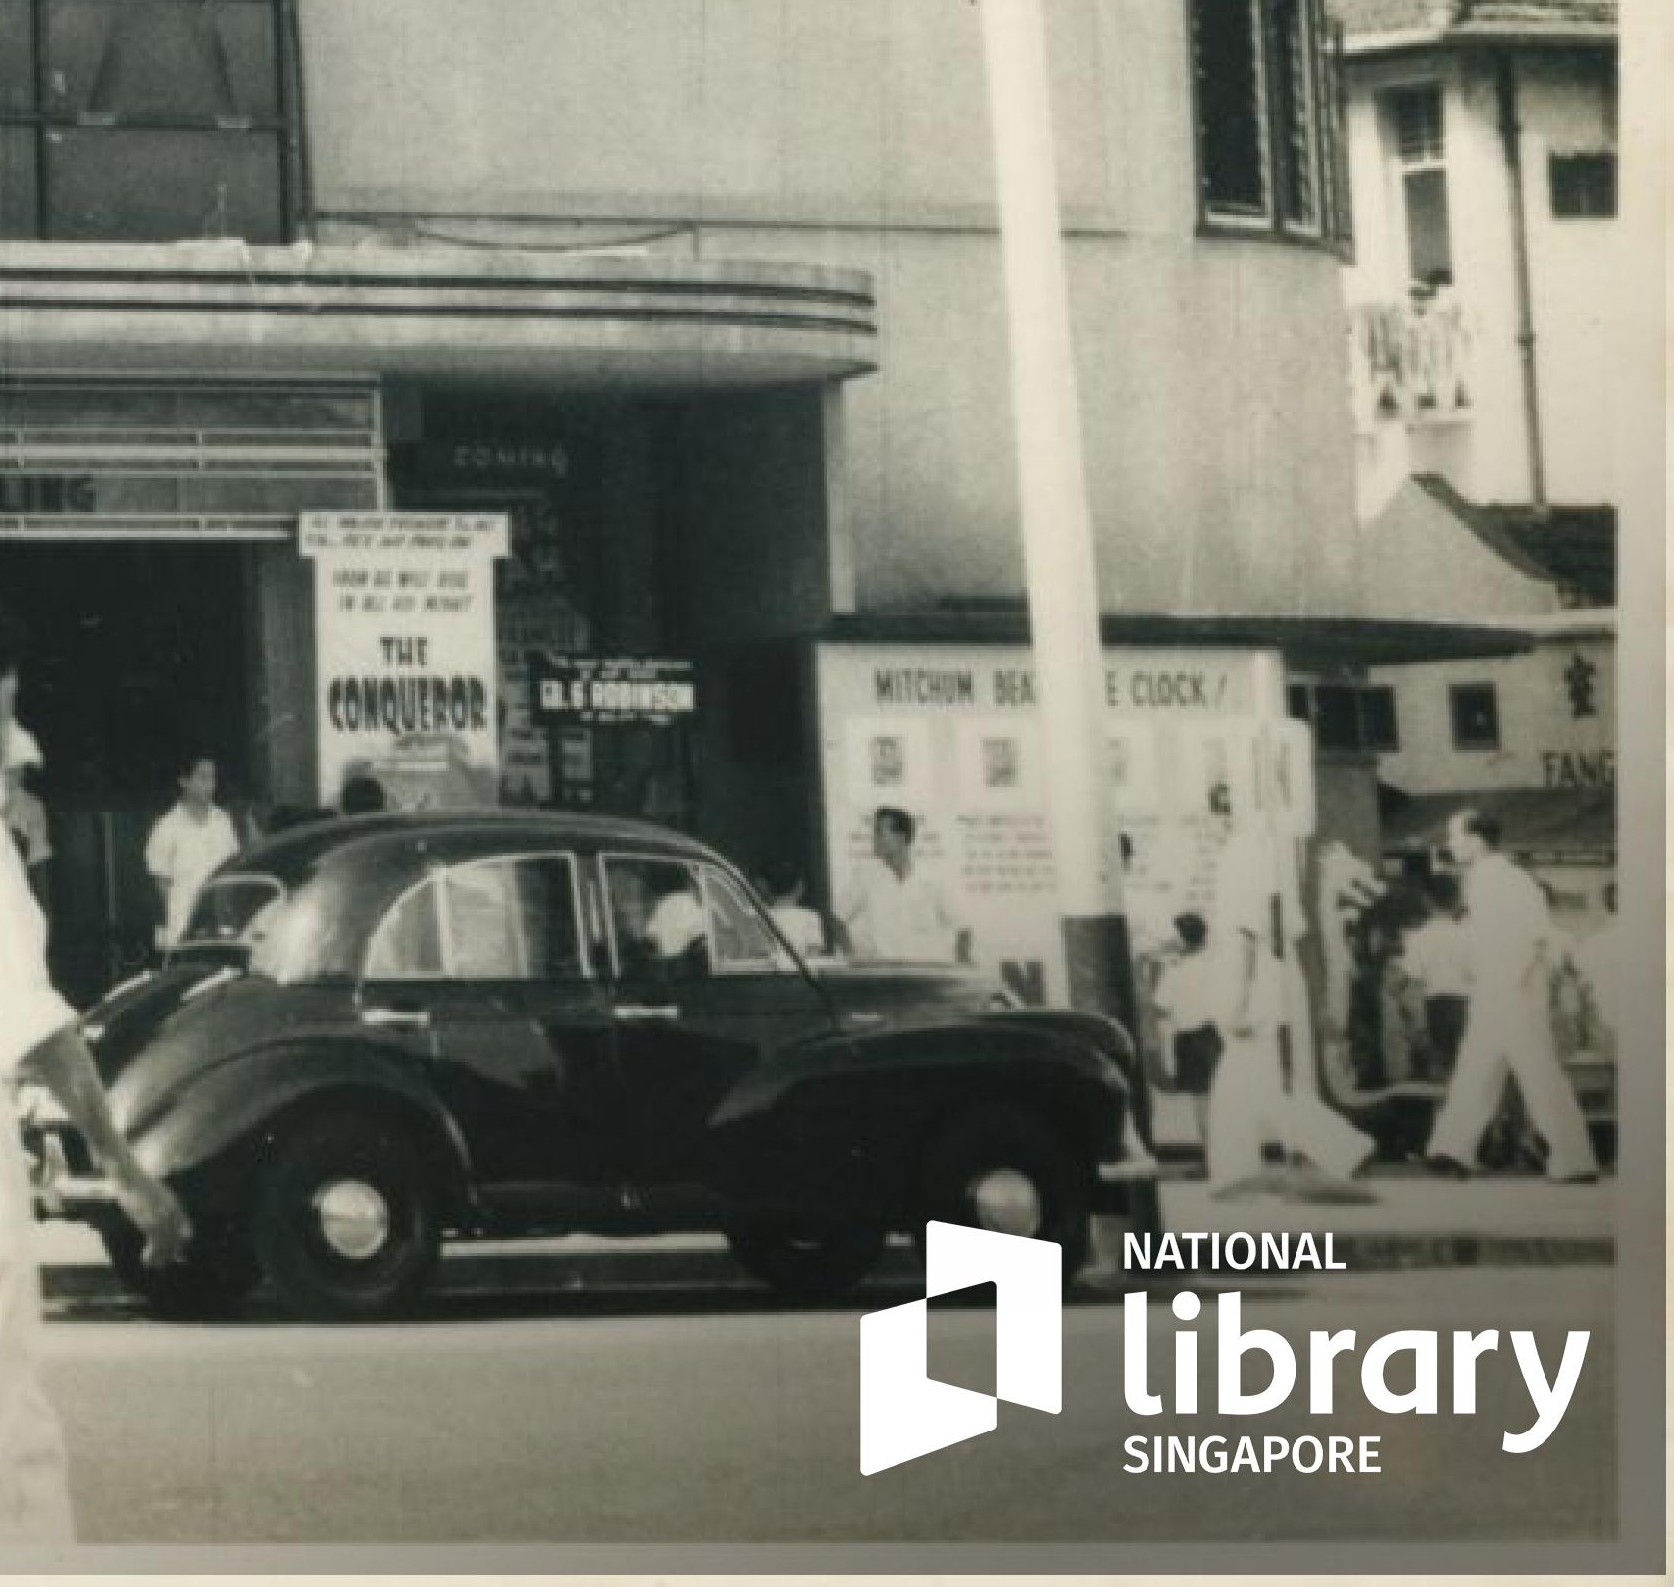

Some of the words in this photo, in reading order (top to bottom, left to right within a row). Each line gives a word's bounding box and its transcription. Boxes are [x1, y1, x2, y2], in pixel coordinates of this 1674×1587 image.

[453, 444, 567, 478] COMING
[379, 636, 428, 667] THE
[874, 667, 973, 706] MITCHUM
[993, 668, 1037, 706] BEA
[328, 675, 487, 735] CONQUEROR
